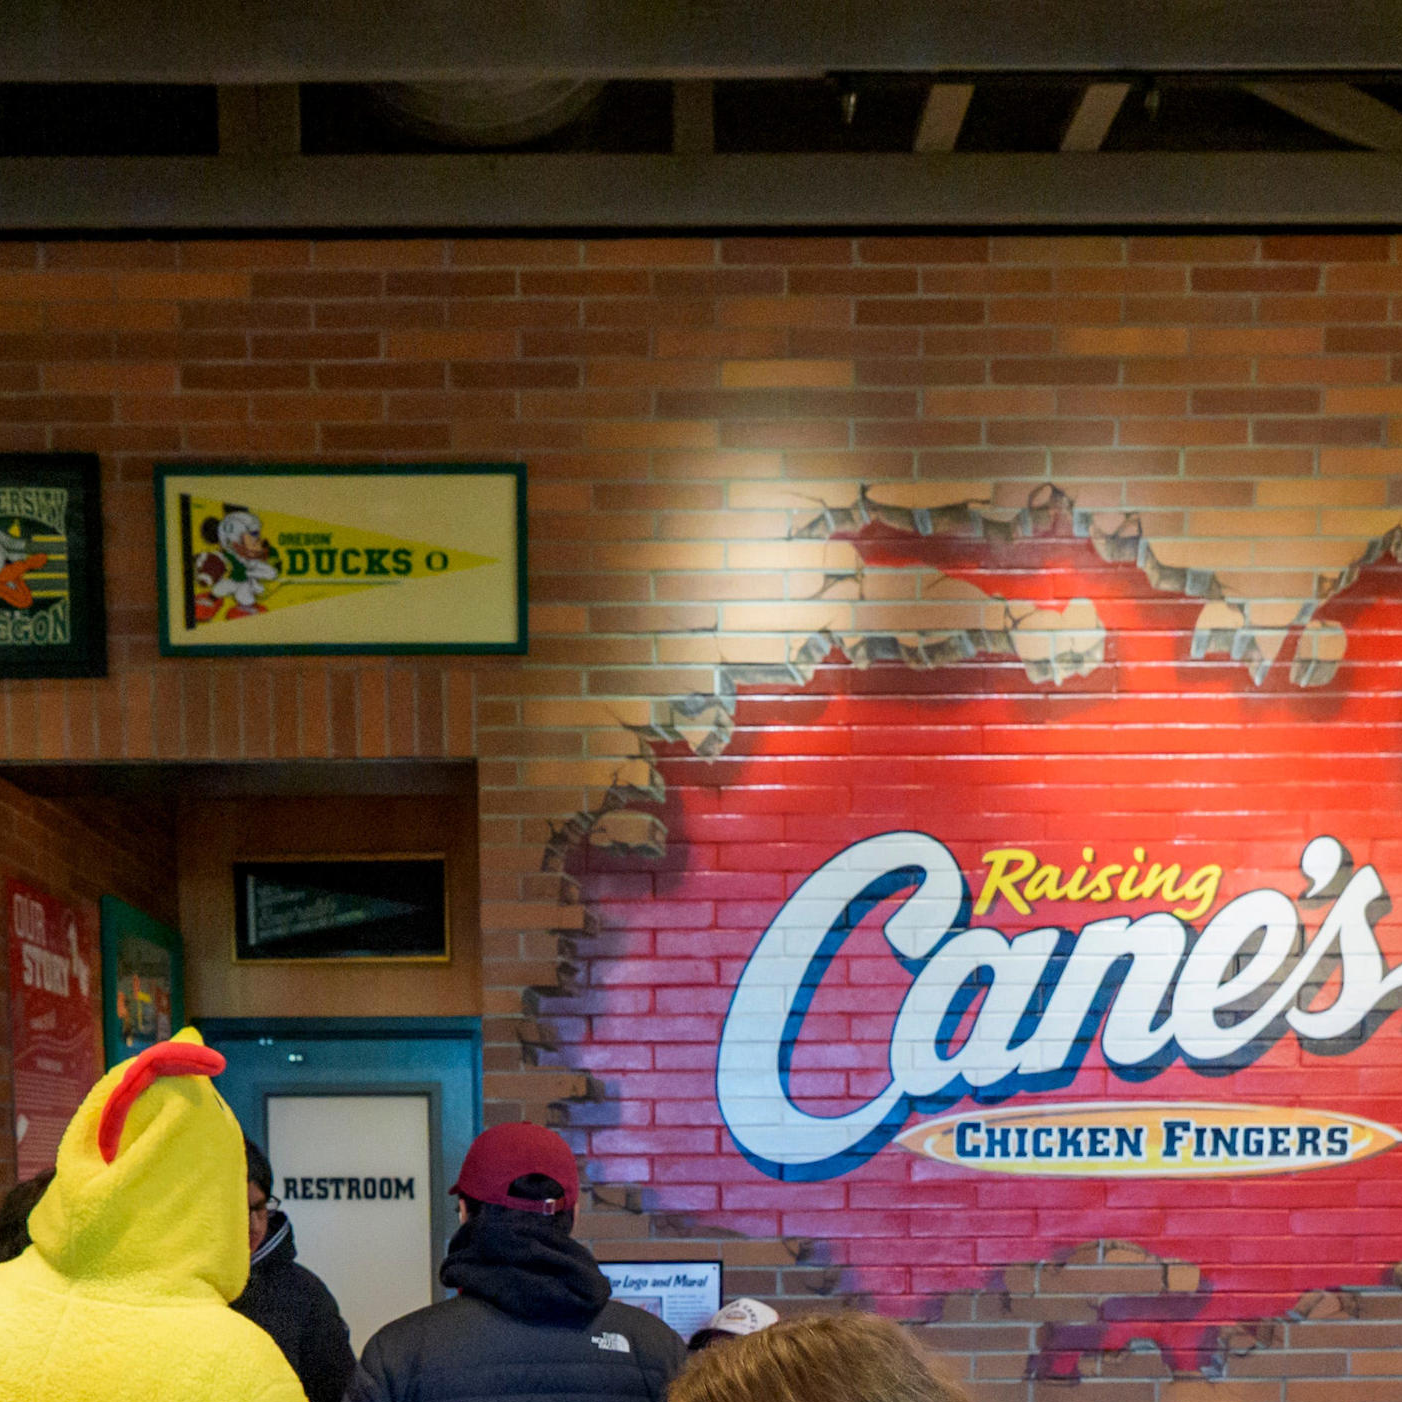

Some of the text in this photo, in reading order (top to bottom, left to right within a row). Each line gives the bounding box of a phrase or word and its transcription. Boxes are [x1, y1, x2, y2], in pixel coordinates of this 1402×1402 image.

[277, 532, 332, 546] OREGON
[285, 547, 414, 577] DUCKS
[973, 846, 1224, 922] Raising
[12, 893, 47, 946] OUR
[22, 944, 72, 998] STORY
[954, 1120, 1352, 1160] CHICKEN FINGERS
[283, 1175, 416, 1202] RESTROOM
[622, 1273, 648, 1291] Logo
[650, 1275, 673, 1288] and
